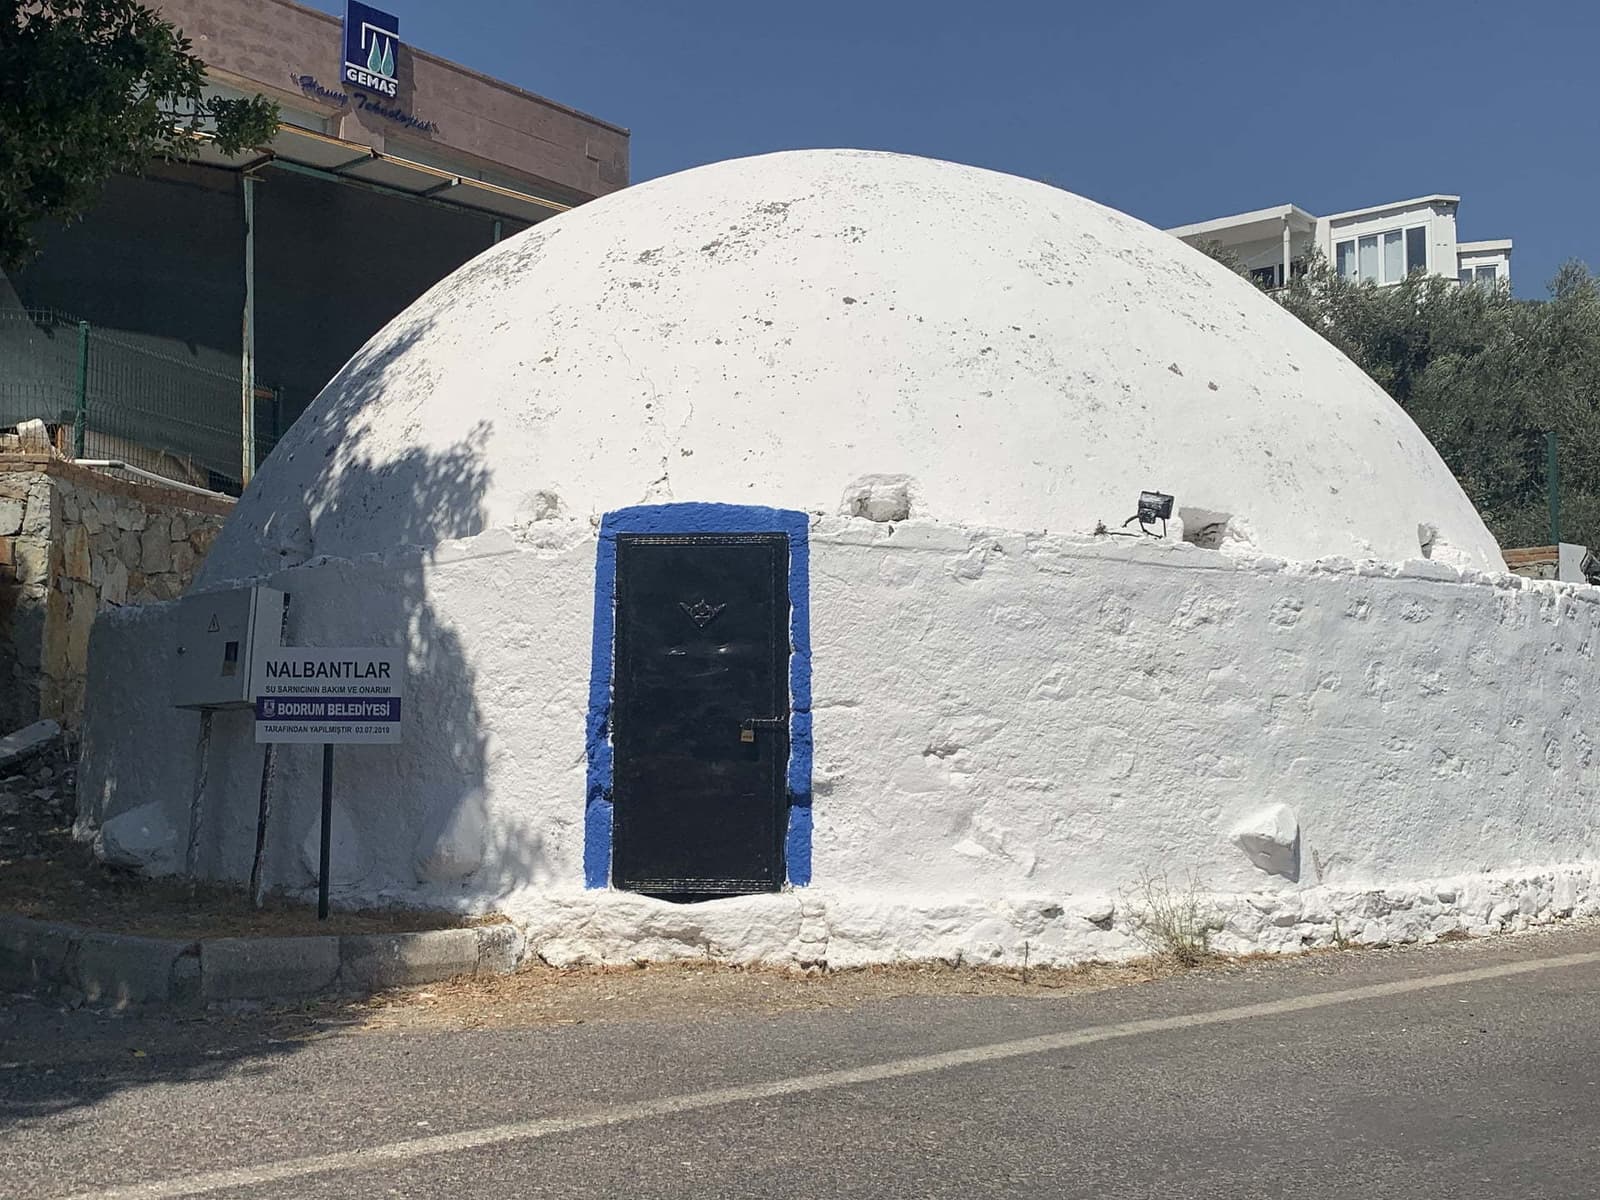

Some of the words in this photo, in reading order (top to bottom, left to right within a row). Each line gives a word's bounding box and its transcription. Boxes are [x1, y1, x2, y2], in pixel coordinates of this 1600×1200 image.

[346, 67, 397, 97] GEMAŞ
[266, 661, 391, 678] NALBANTLAR
[265, 685, 276, 693] SU
[278, 703, 325, 716] BODRUM
[327, 700, 390, 717] BELEDİYESİ
[264, 725, 308, 733] TARAFINDAN
